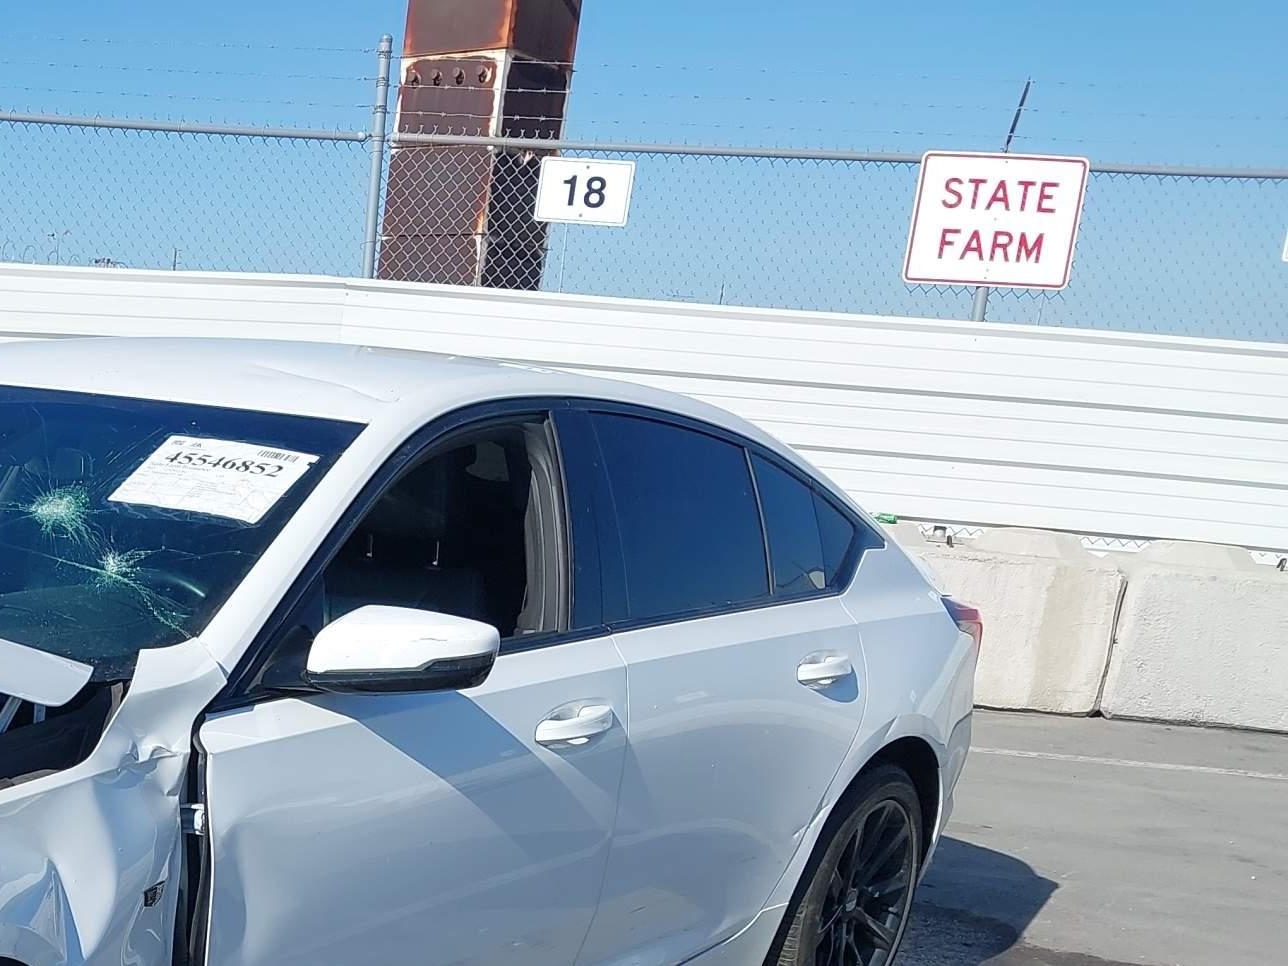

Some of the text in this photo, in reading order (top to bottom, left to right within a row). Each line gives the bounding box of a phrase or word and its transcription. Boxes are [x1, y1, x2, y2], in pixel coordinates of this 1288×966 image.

[563, 174, 607, 209] 18
[941, 177, 1060, 214] STATE
[937, 228, 1045, 264] FARM
[165, 451, 284, 478] 45546852
